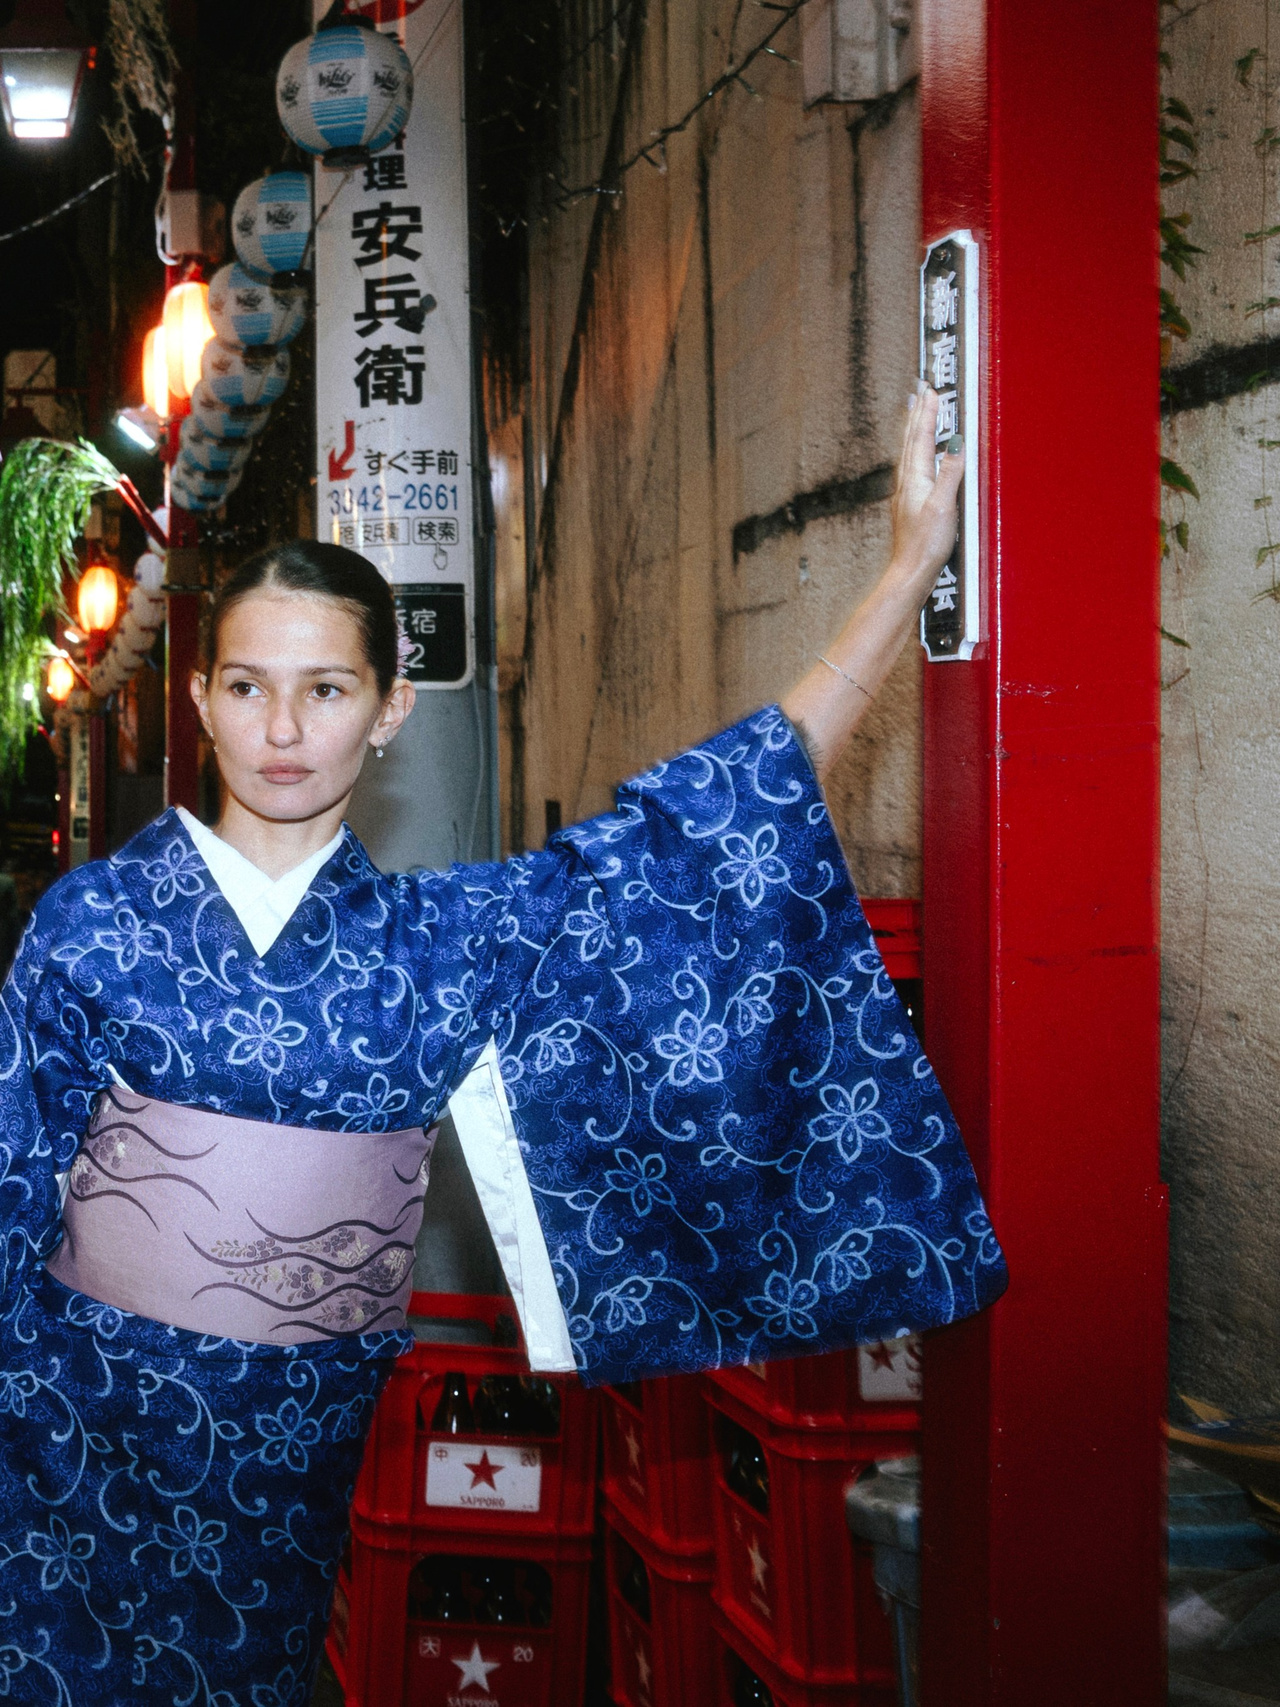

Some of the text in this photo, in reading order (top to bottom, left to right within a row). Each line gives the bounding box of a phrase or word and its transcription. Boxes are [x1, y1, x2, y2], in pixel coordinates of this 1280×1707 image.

[352, 202, 426, 408] 安兵衛
[364, 449, 458, 476] すぐ手前
[330, 483, 458, 515] 3342-2661
[417, 521, 456, 542] 検索
[460, 1495, 505, 1509] SAPPORO
[422, 1639, 437, 1656] 大
[513, 1645, 534, 1662] 20
